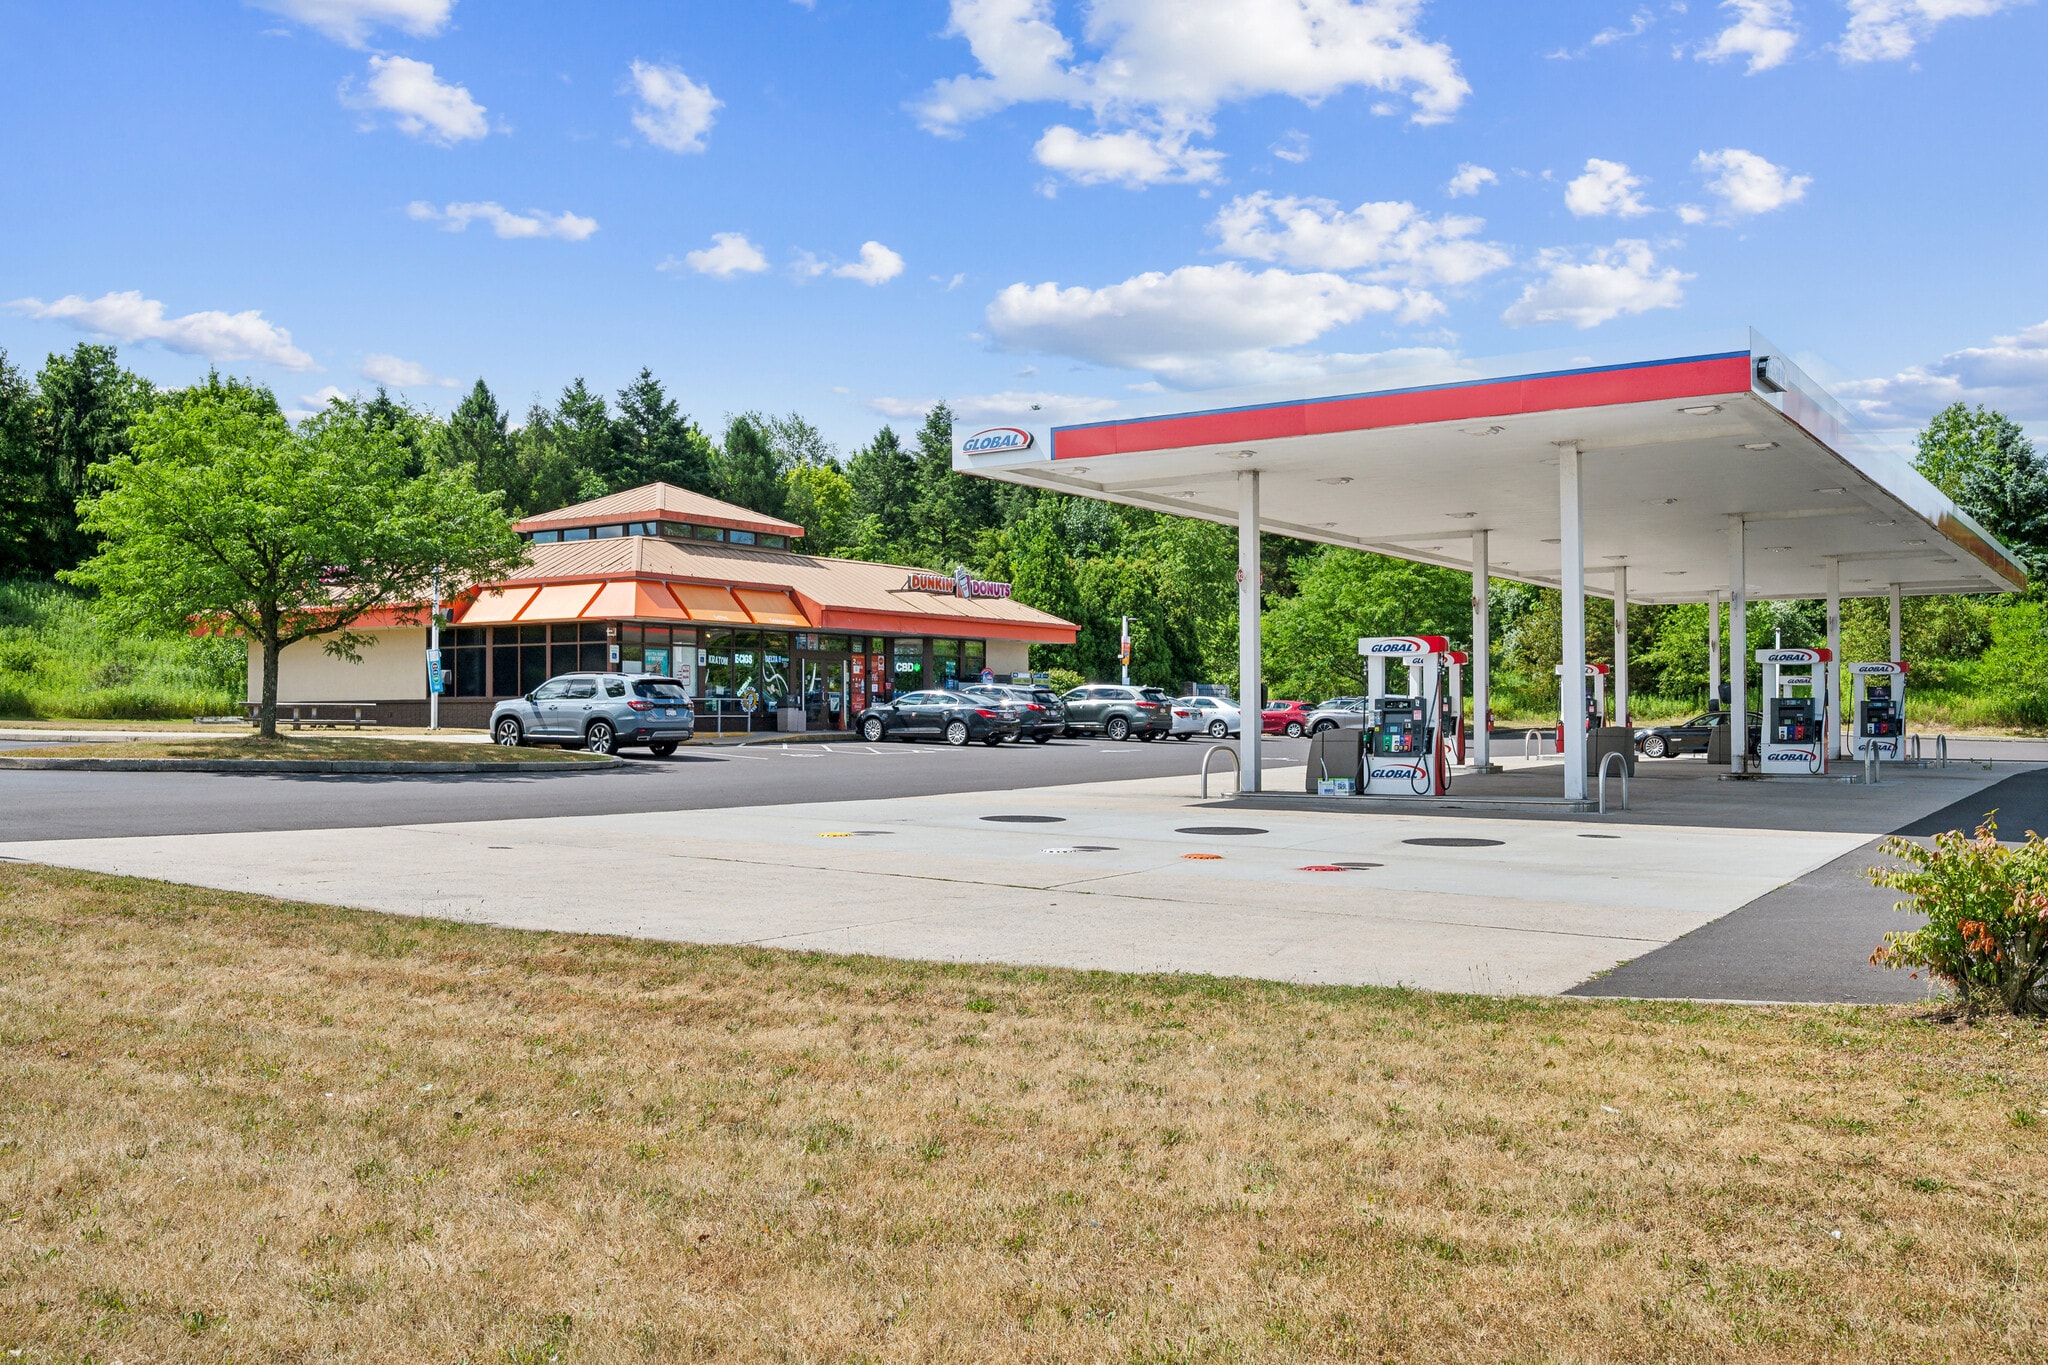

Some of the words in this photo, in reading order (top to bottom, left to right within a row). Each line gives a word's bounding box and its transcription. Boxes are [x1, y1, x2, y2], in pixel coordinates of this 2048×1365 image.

[962, 434, 1019, 452] GLOBAL
[971, 580, 1012, 599] DONUTS
[1371, 643, 1413, 653] GLOBAL
[708, 655, 729, 666] KRATOM
[1768, 653, 1806, 662] GLOBAL
[895, 662, 914, 673] CBD
[1858, 665, 1889, 673] GLOBAL
[1767, 753, 1810, 761] GLOBAL
[1371, 768, 1418, 779] GLOBAL
